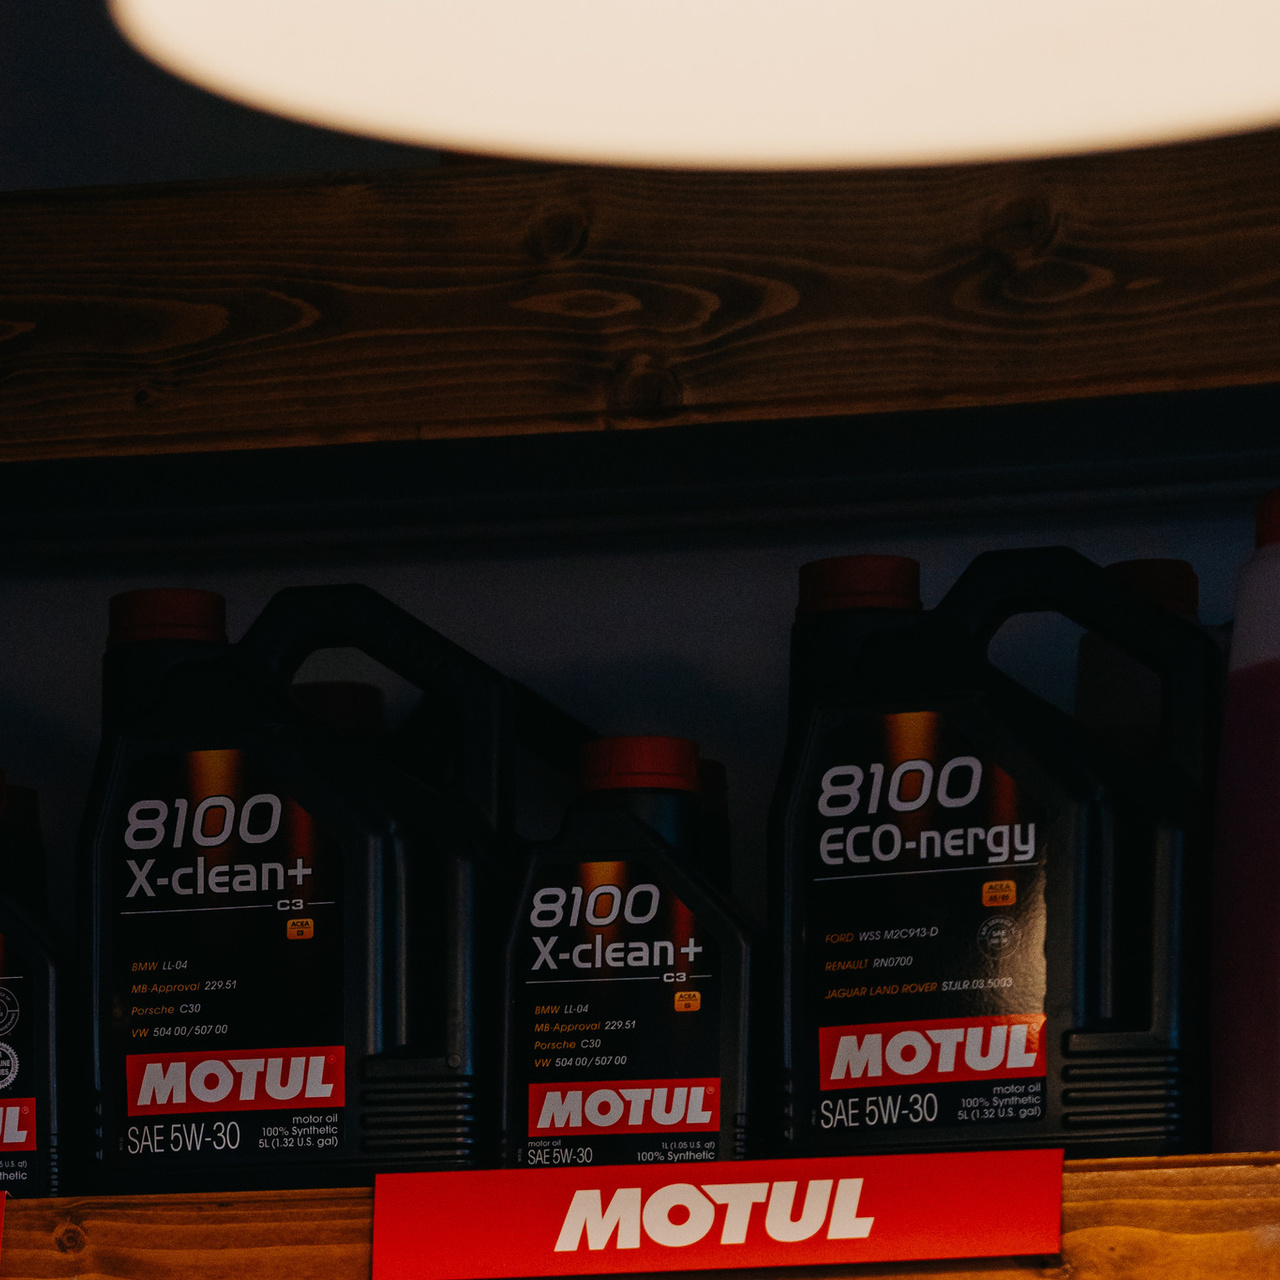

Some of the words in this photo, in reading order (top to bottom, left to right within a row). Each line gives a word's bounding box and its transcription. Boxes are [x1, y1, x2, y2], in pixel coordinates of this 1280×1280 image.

[818, 756, 983, 818] 8100
[124, 793, 282, 850] 8100
[820, 823, 1036, 866] ECO-nergy
[126, 856, 313, 898] X-clean+
[277, 899, 304, 910] C3
[530, 884, 660, 928] 8100
[531, 934, 703, 970] X-clean+
[825, 932, 854, 944] FORD
[859, 929, 881, 941] WSS
[131, 961, 158, 972] BMW
[162, 960, 188, 971] LL-04
[663, 972, 687, 982] C3
[825, 959, 869, 971] RENAULT
[131, 981, 200, 995] MB-Approval
[204, 980, 237, 991] 229.51
[825, 986, 867, 999] JAGUAR
[869, 984, 899, 996] LAND
[902, 981, 937, 994] ROVER
[131, 1005, 175, 1015] Porsche
[179, 1003, 201, 1014] C30
[830, 1024, 1038, 1080] MOTUL
[137, 1056, 334, 1106] MOTUL
[293, 1114, 320, 1124] motor
[324, 1112, 338, 1122] oil
[536, 1086, 712, 1129] MOTUL
[821, 1099, 860, 1130] SAE
[865, 1092, 938, 1126] 5W-30
[128, 1125, 164, 1155] SAE
[170, 1121, 240, 1152] 5W-30
[262, 1125, 289, 1136] 100%
[291, 1124, 338, 1137] Synthetic
[528, 1148, 550, 1164] SAE
[553, 1148, 592, 1164] 5W-30
[553, 1177, 875, 1253] MOTUL
